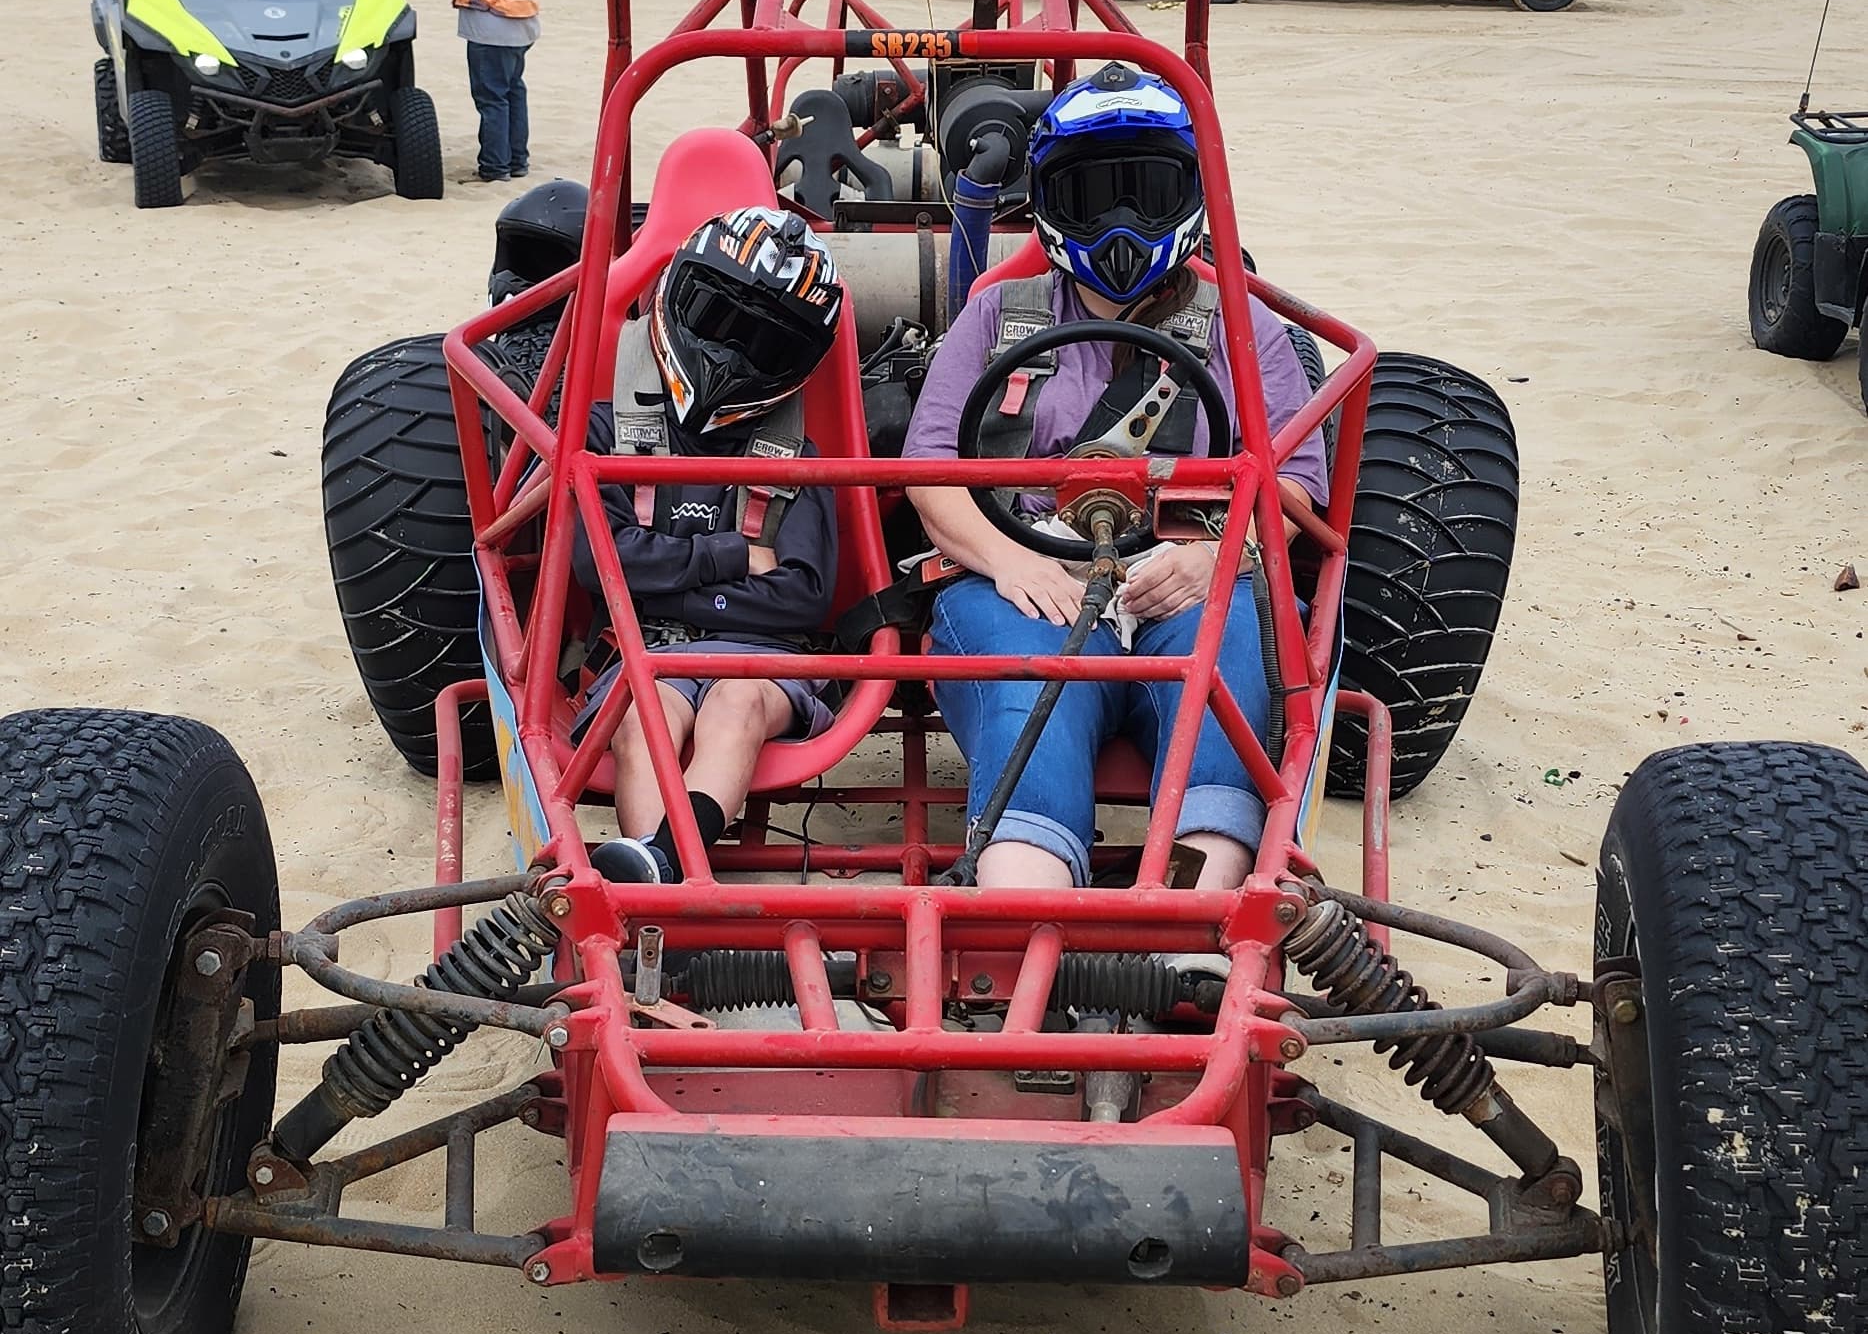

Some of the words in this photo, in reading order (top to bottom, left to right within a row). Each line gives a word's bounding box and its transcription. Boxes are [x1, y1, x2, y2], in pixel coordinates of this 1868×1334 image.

[871, 32, 952, 58] SB235
[1006, 324, 1036, 335] CROW
[754, 441, 784, 456] CROW
